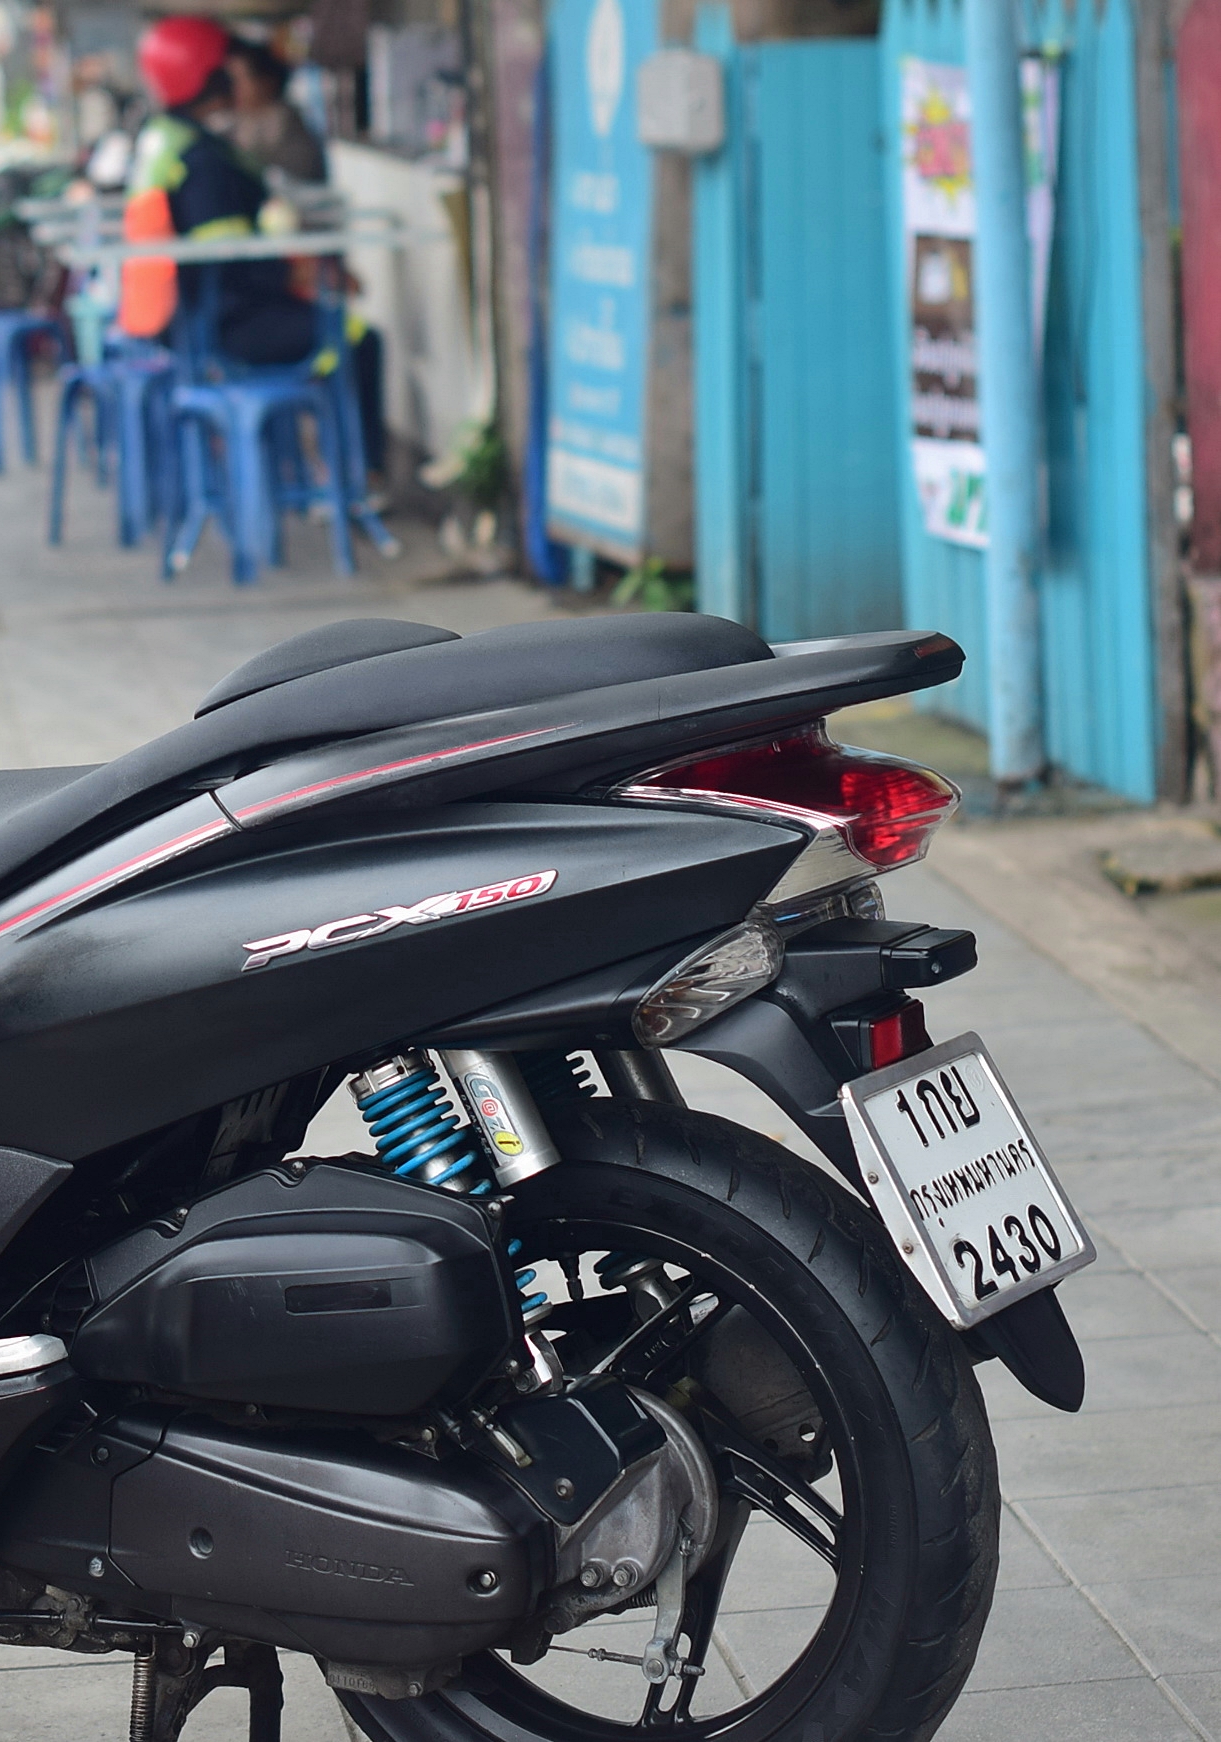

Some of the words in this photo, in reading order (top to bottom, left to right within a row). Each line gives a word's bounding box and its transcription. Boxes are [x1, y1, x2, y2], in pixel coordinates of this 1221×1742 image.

[894, 1065, 981, 1148] 1กย
[909, 1138, 1036, 1228] กรุงเทพมหานคร
[952, 1203, 1062, 1300] 2430
[285, 1550, 415, 1586] HONDA
